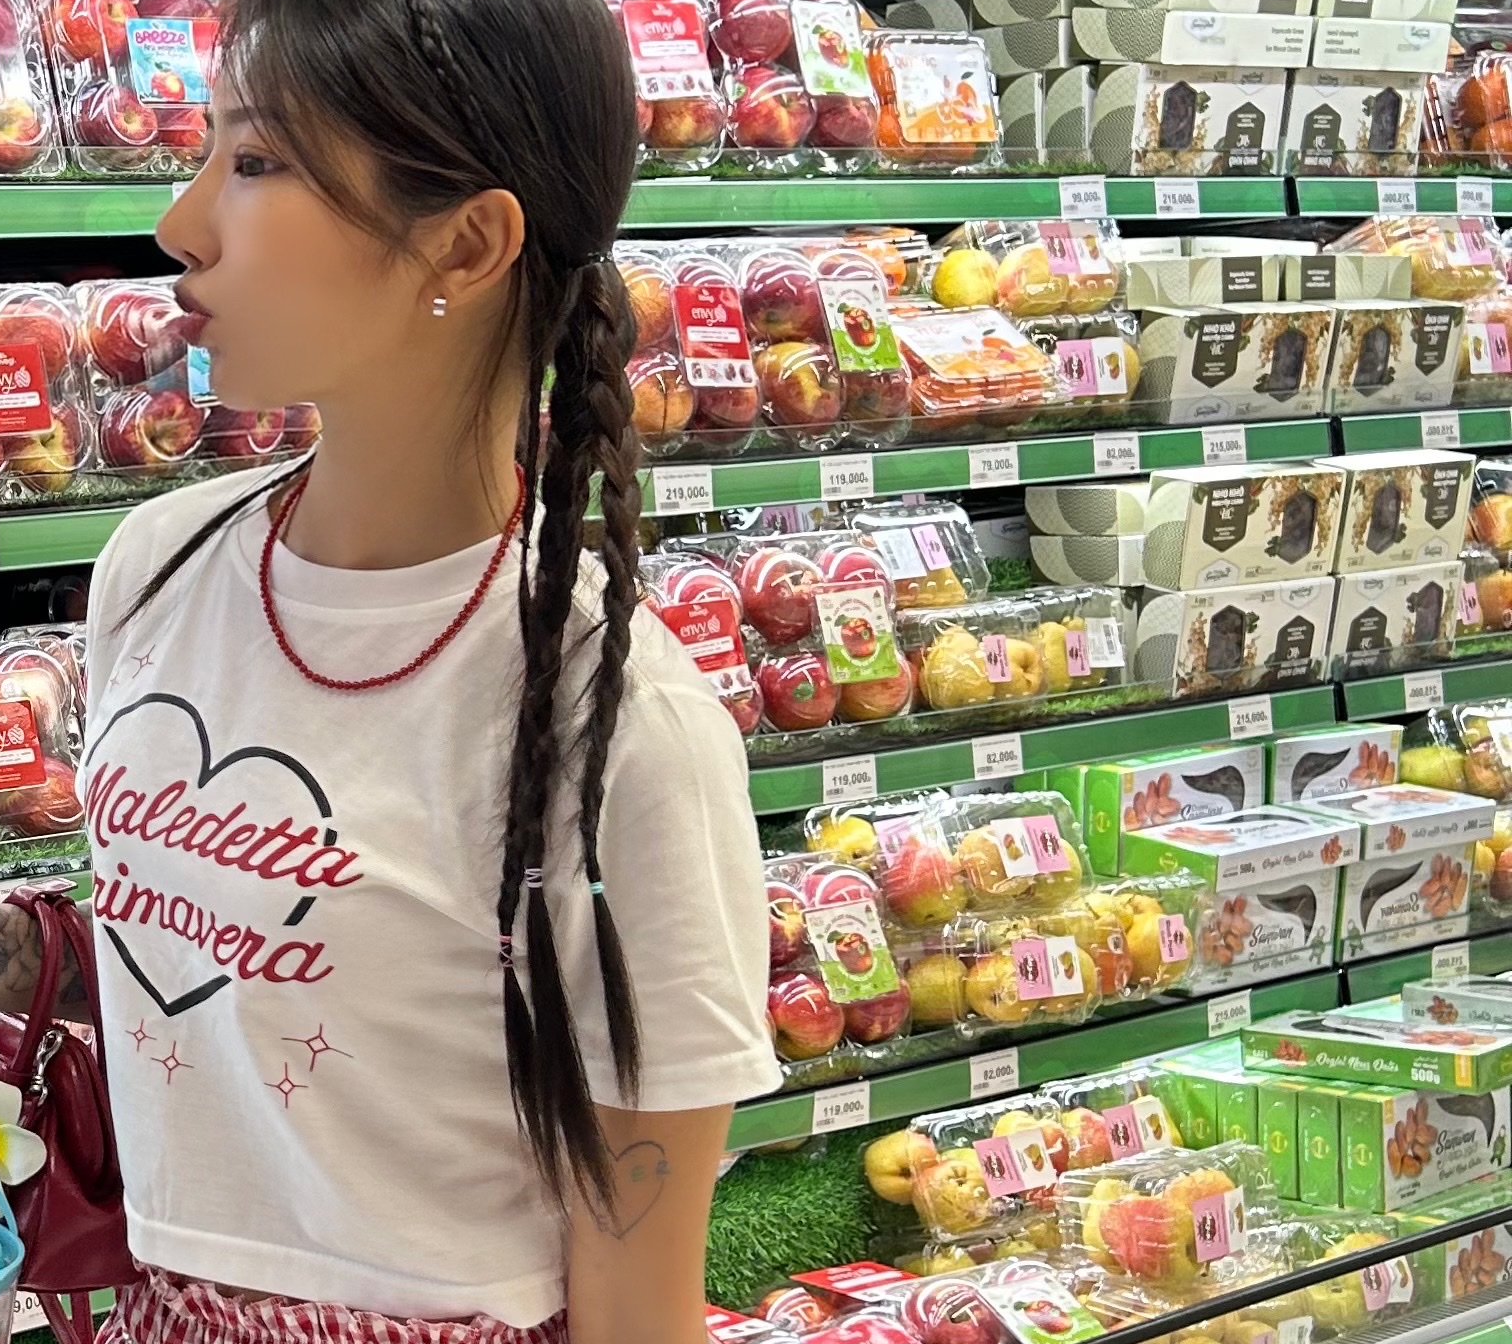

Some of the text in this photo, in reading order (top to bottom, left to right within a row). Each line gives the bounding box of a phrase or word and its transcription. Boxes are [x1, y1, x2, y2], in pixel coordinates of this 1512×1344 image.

[691, 307, 716, 326] envy
[680, 621, 708, 641] envy
[87, 761, 364, 888] Maledetta
[93, 862, 335, 984] rimavera
